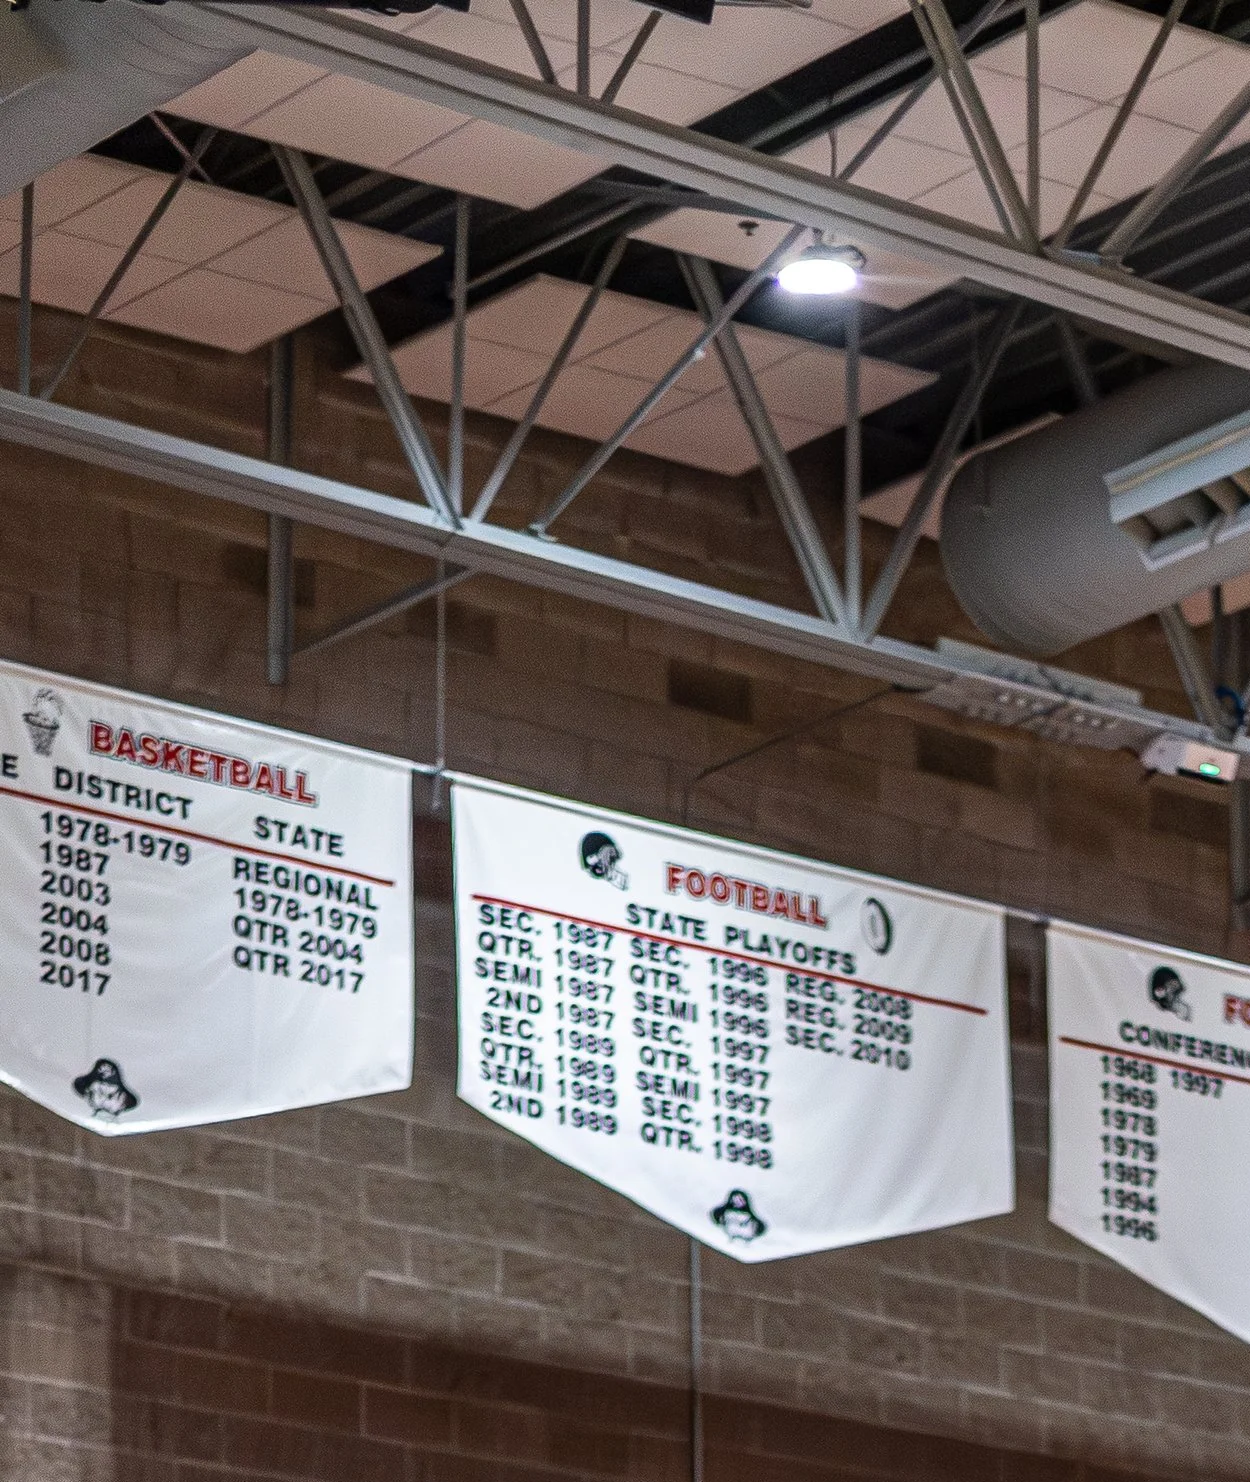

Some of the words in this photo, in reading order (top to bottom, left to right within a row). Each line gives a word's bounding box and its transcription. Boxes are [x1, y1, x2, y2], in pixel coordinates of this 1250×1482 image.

[87, 718, 319, 808] BASKETBALL
[53, 765, 193, 820] DISTRICT
[39, 840, 110, 876] 1987
[40, 810, 191, 866] 1978-1979
[253, 814, 344, 857] STATE
[39, 869, 111, 906] 2003
[232, 855, 379, 912] REGIONAL
[665, 861, 829, 931] FOOTBALL
[40, 901, 109, 936] 2004
[233, 886, 378, 939] 1978-1979
[476, 900, 542, 936] SEC.
[552, 918, 616, 951] 1987
[39, 929, 112, 966] 2008
[232, 913, 290, 948] QTR
[298, 929, 364, 965] 2004
[476, 930, 542, 962] QTR.
[553, 947, 615, 977] 1987
[626, 902, 708, 942] STATE
[723, 924, 857, 975] PLAYOFFS
[626, 934, 692, 969] SEC.
[705, 951, 771, 987] 1996
[39, 959, 111, 996] 2017
[231, 944, 291, 977] QTR
[299, 959, 365, 993] 2017
[474, 956, 542, 989] SEMI
[554, 974, 615, 1004] 1987
[486, 986, 543, 1015] 2ND
[555, 1001, 615, 1031] 1987
[633, 990, 698, 1023] SEMI
[709, 1008, 770, 1039] 1996
[708, 982, 769, 1013] 1996
[481, 1011, 543, 1042] SEC.
[554, 1027, 616, 1058] 1989
[631, 1016, 692, 1048] SEC.
[710, 1034, 771, 1064] 1997
[479, 1059, 544, 1093] SEMI
[556, 1078, 618, 1109] 1989
[555, 1054, 617, 1085] 1989
[635, 1069, 700, 1102] SEMI
[711, 1087, 771, 1117] 1997
[710, 1061, 771, 1090] 1997
[489, 1089, 544, 1119] 2ND
[555, 1104, 619, 1136] 1989
[641, 1095, 702, 1127] SEC.
